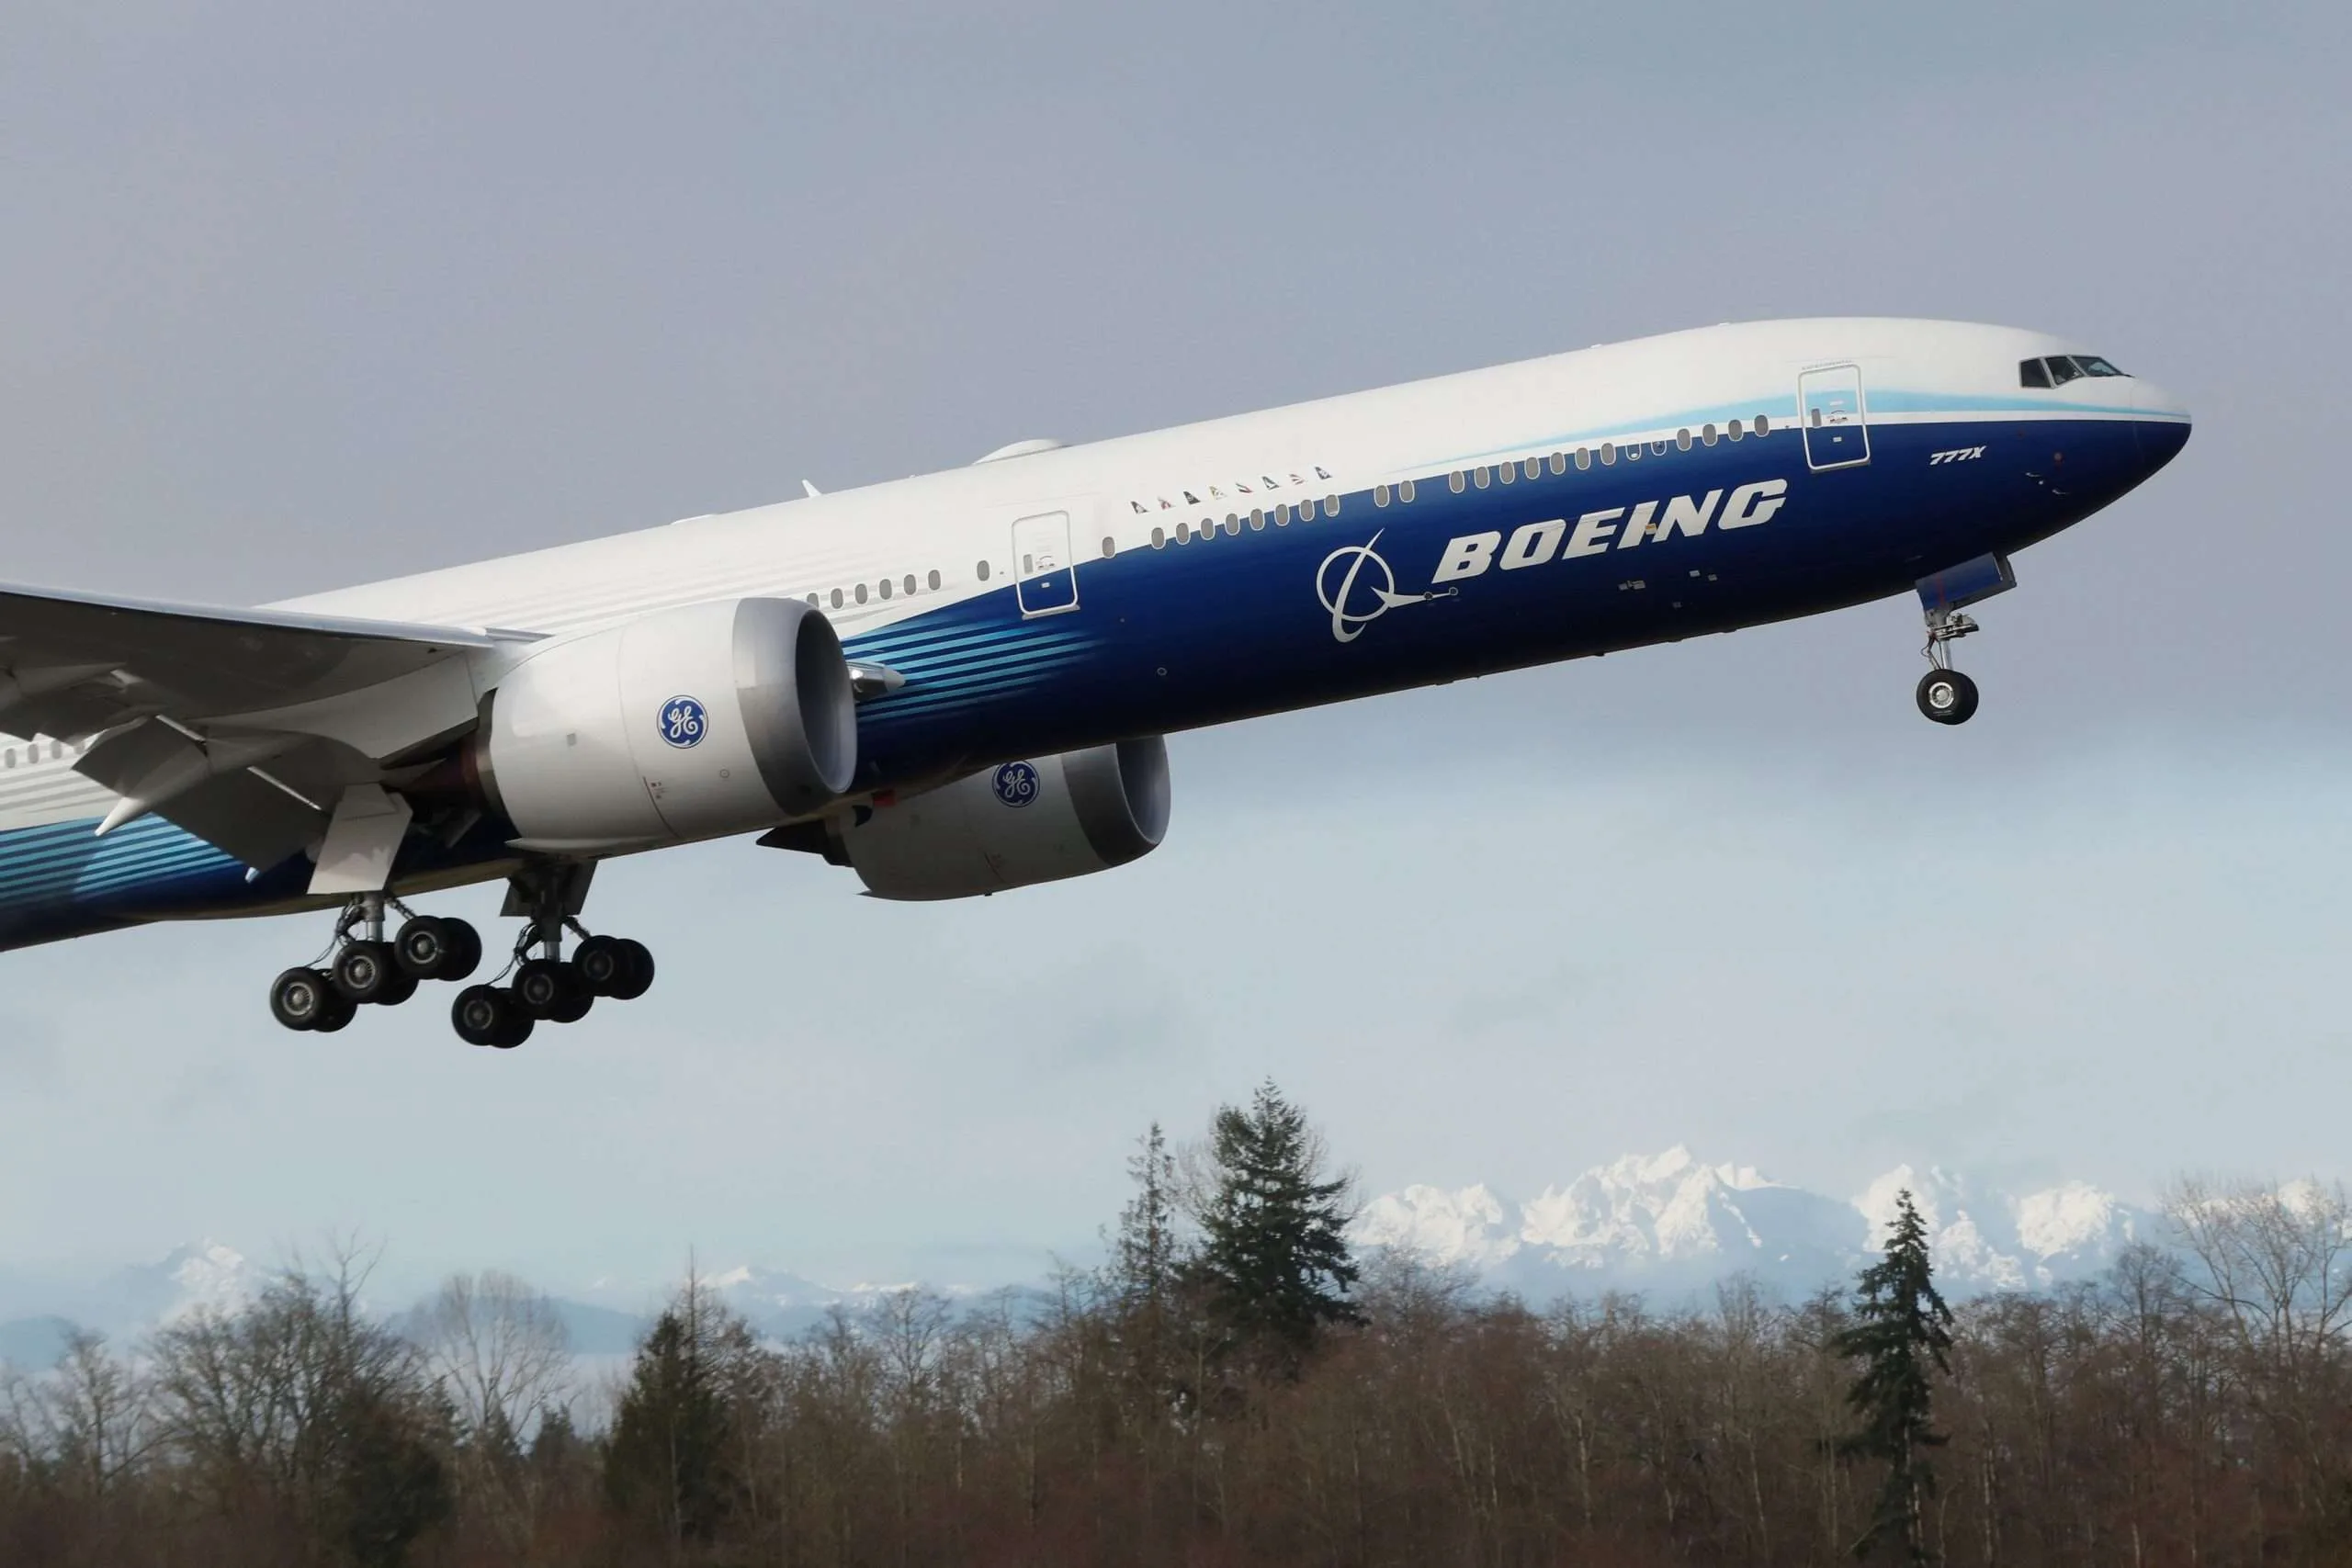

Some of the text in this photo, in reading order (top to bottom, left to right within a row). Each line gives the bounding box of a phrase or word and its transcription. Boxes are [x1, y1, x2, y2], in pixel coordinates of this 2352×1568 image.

[1929, 445, 1986, 466] 777X
[1431, 479, 1787, 583] BOEING
[667, 705, 698, 738] GE
